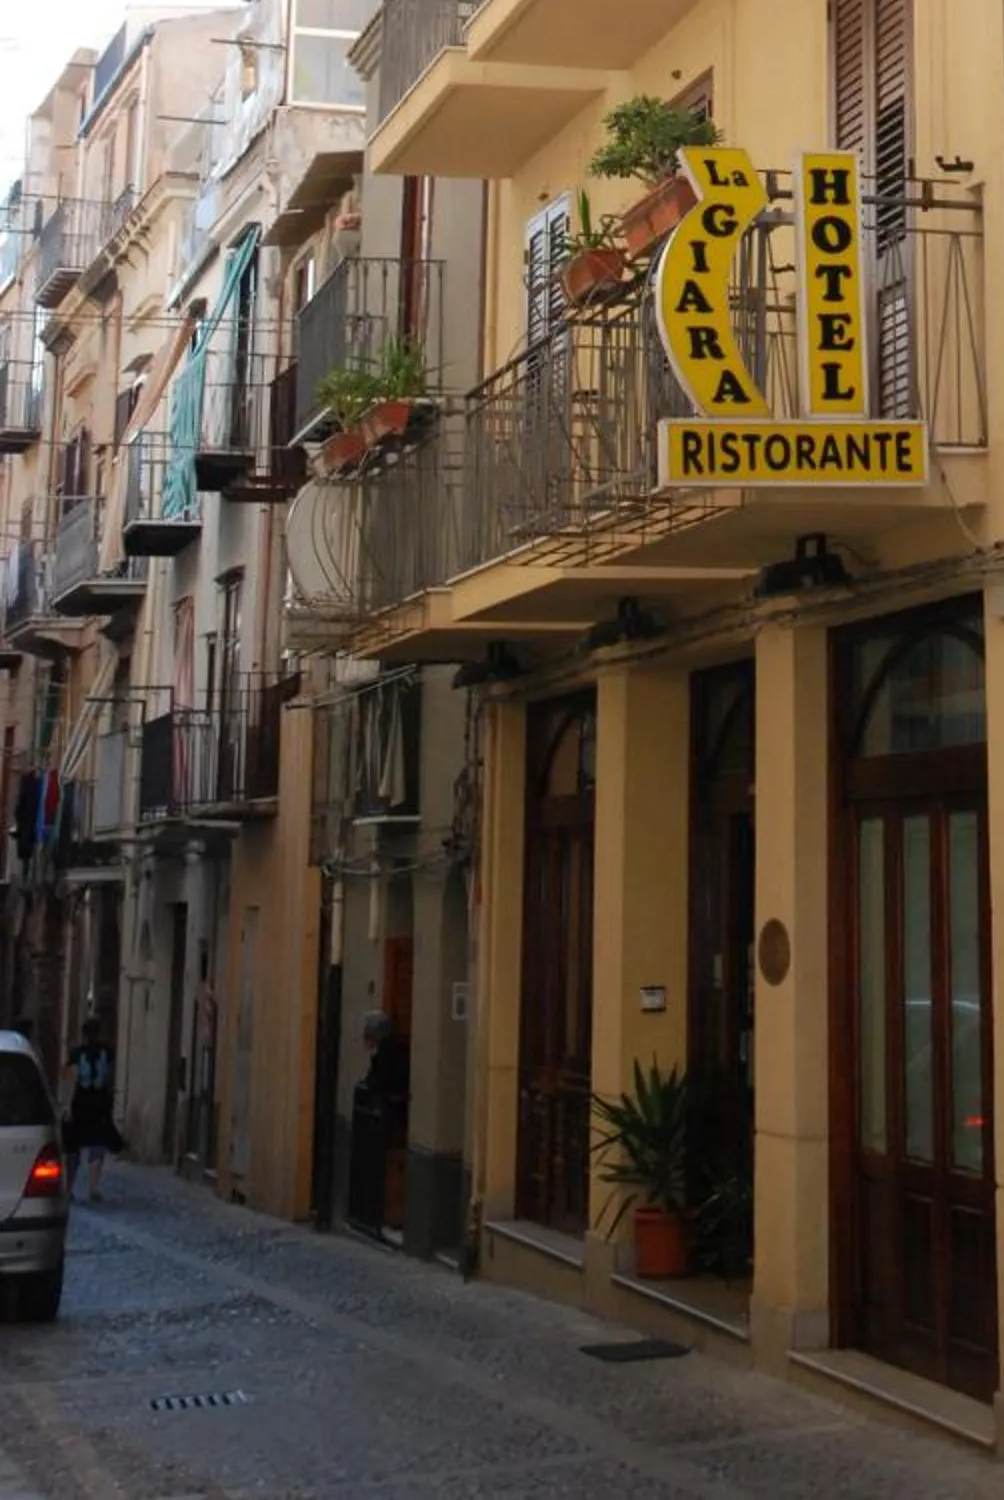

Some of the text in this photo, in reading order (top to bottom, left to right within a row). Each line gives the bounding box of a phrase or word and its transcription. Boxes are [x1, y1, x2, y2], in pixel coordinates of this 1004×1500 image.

[704, 159, 749, 188] La
[675, 203, 751, 404] GIARA
[809, 168, 855, 402] HOTEL
[682, 430, 913, 476] RISTORANTE
